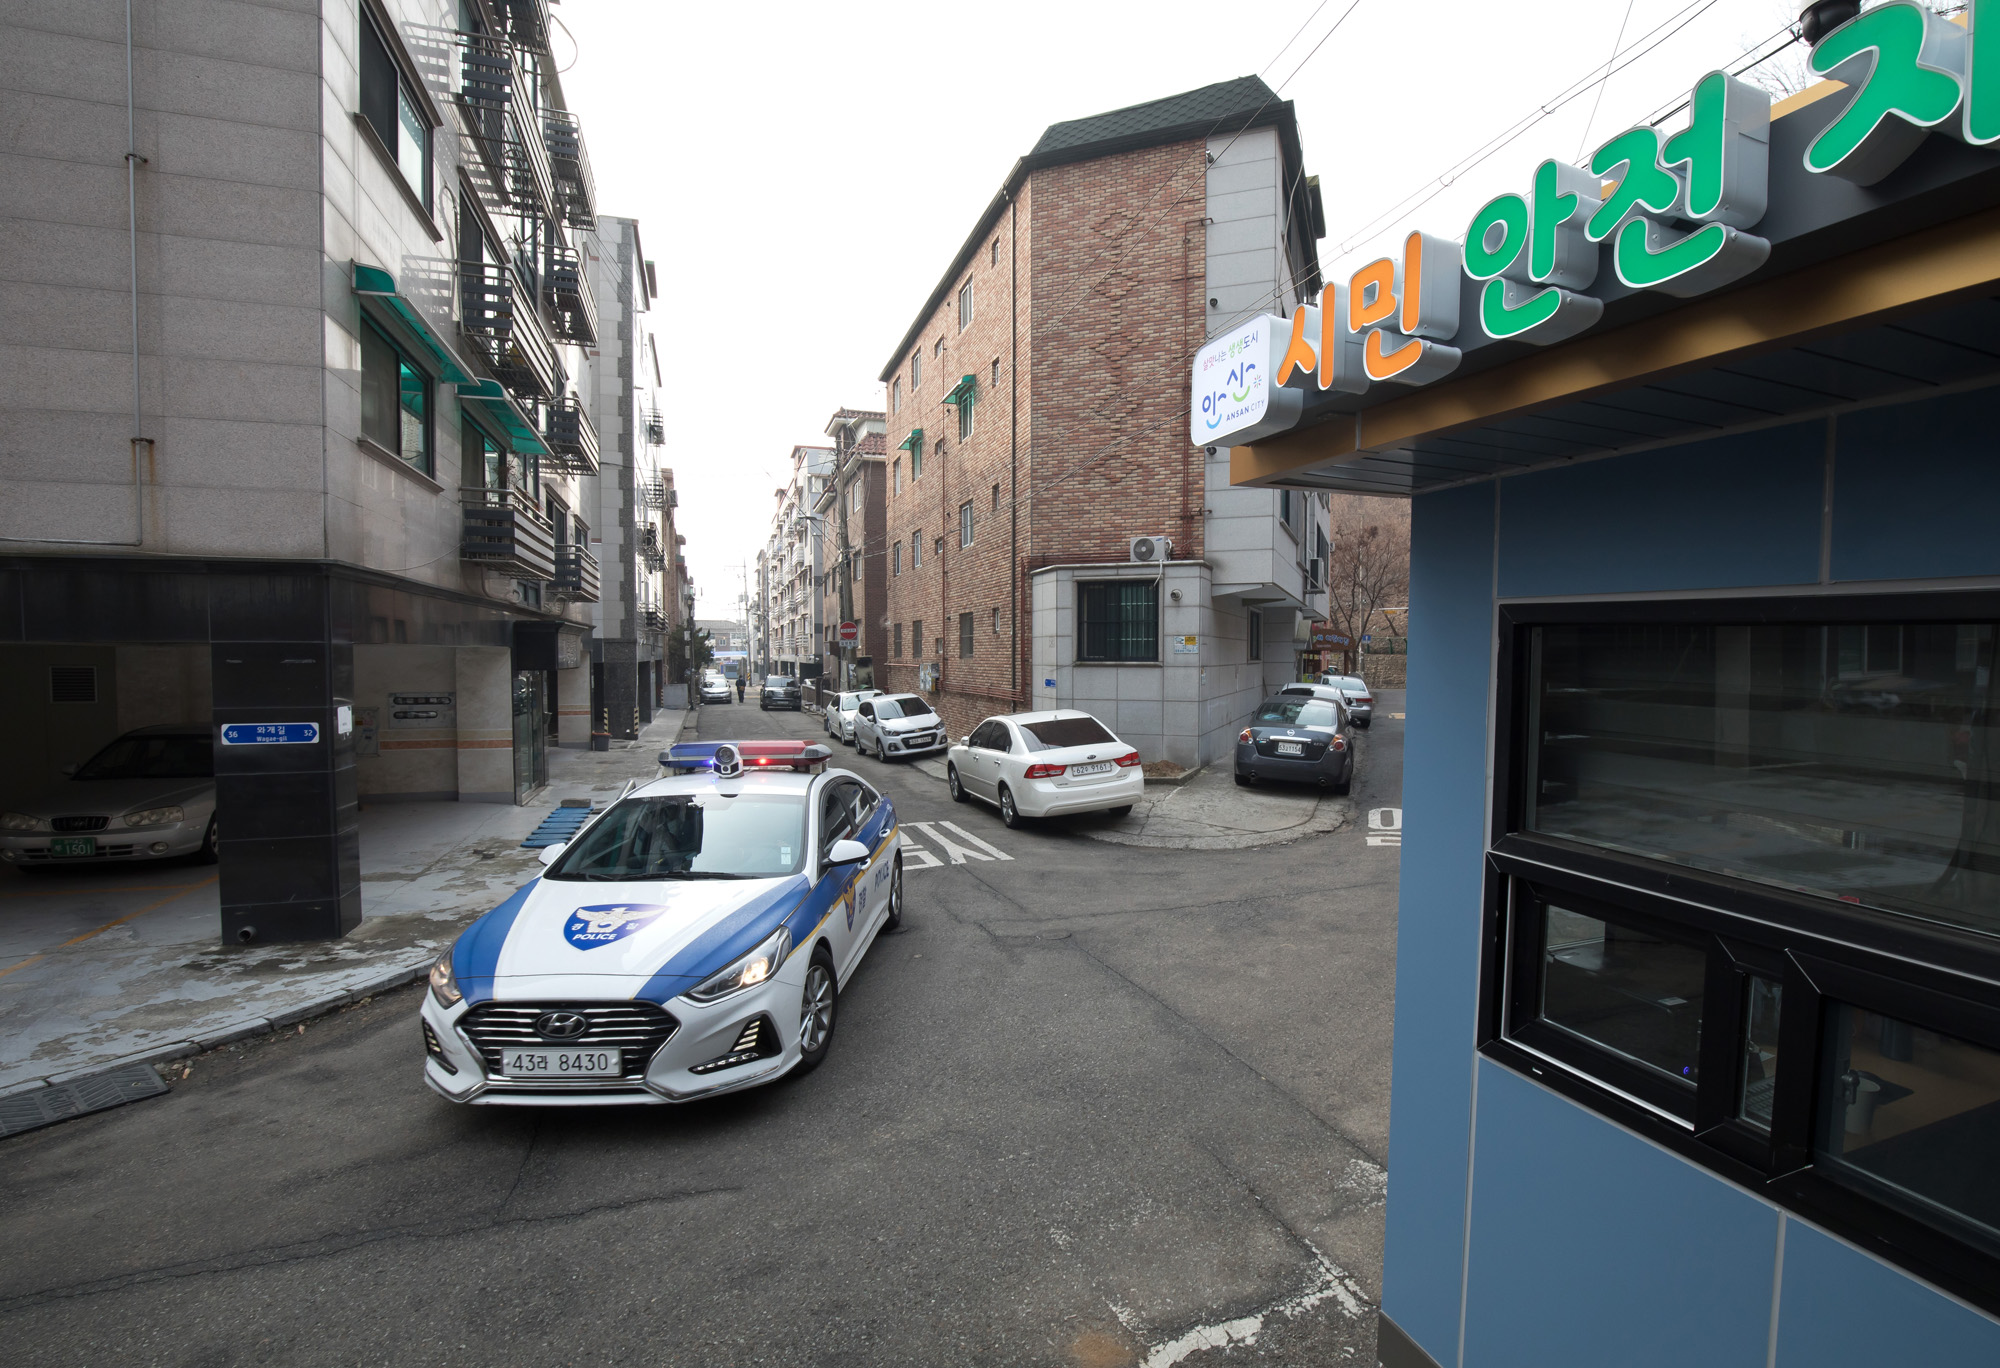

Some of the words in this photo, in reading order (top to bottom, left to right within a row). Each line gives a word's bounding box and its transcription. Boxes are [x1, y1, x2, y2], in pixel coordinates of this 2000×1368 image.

[1275, 230, 1424, 391] 시민
[1462, 69, 1729, 339] 안전
[1203, 350, 1227, 371] 살맛나는
[1228, 330, 1259, 358] 생생도시
[1202, 361, 1256, 430] 안산
[1226, 405, 1249, 421] ANSAN
[1251, 399, 1265, 411] CITY
[256, 726, 285, 735] 와개길
[1091, 763, 1107, 771] 9161
[66, 844, 91, 855] 1501
[512, 1053, 549, 1071] 43라
[559, 1053, 608, 1071] 8430
